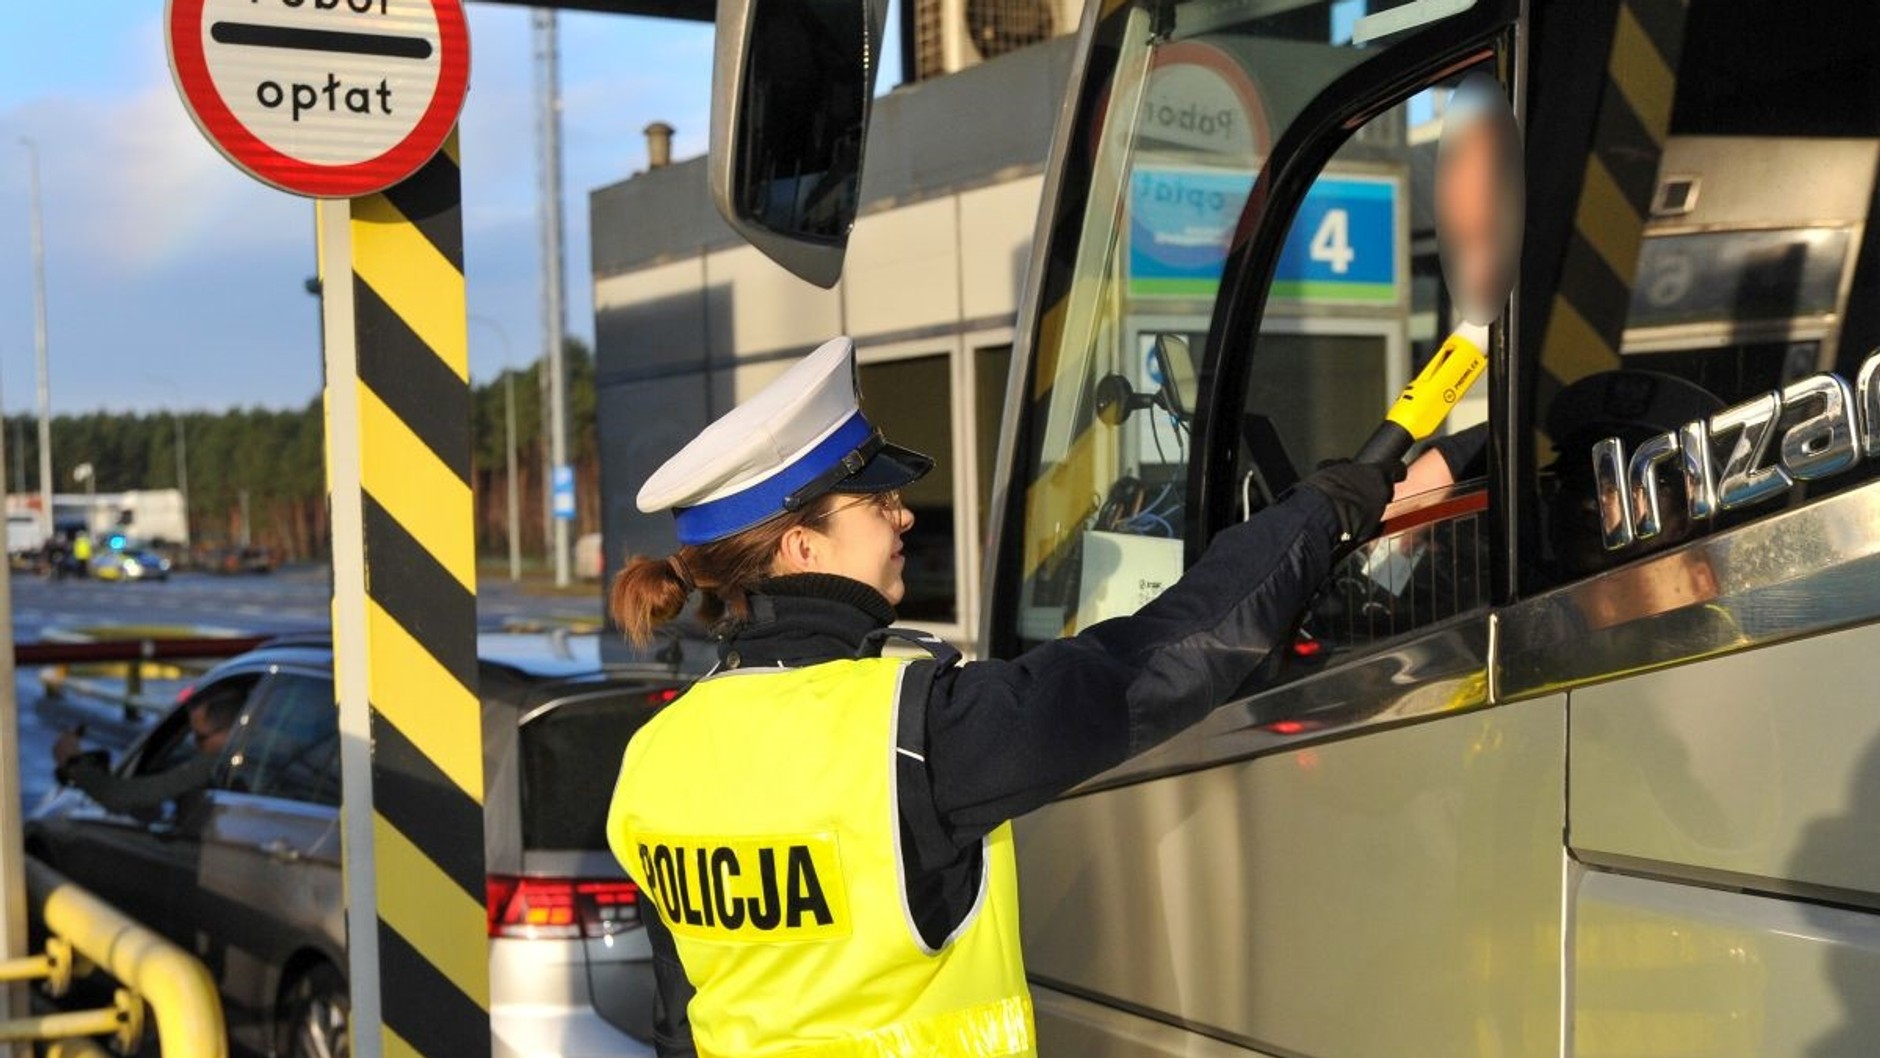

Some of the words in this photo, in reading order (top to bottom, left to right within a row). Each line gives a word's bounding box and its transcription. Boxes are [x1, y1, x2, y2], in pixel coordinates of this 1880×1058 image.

[256, 73, 393, 121] opłat
[1309, 209, 1354, 274] 4
[638, 843, 834, 930] POLICJA
